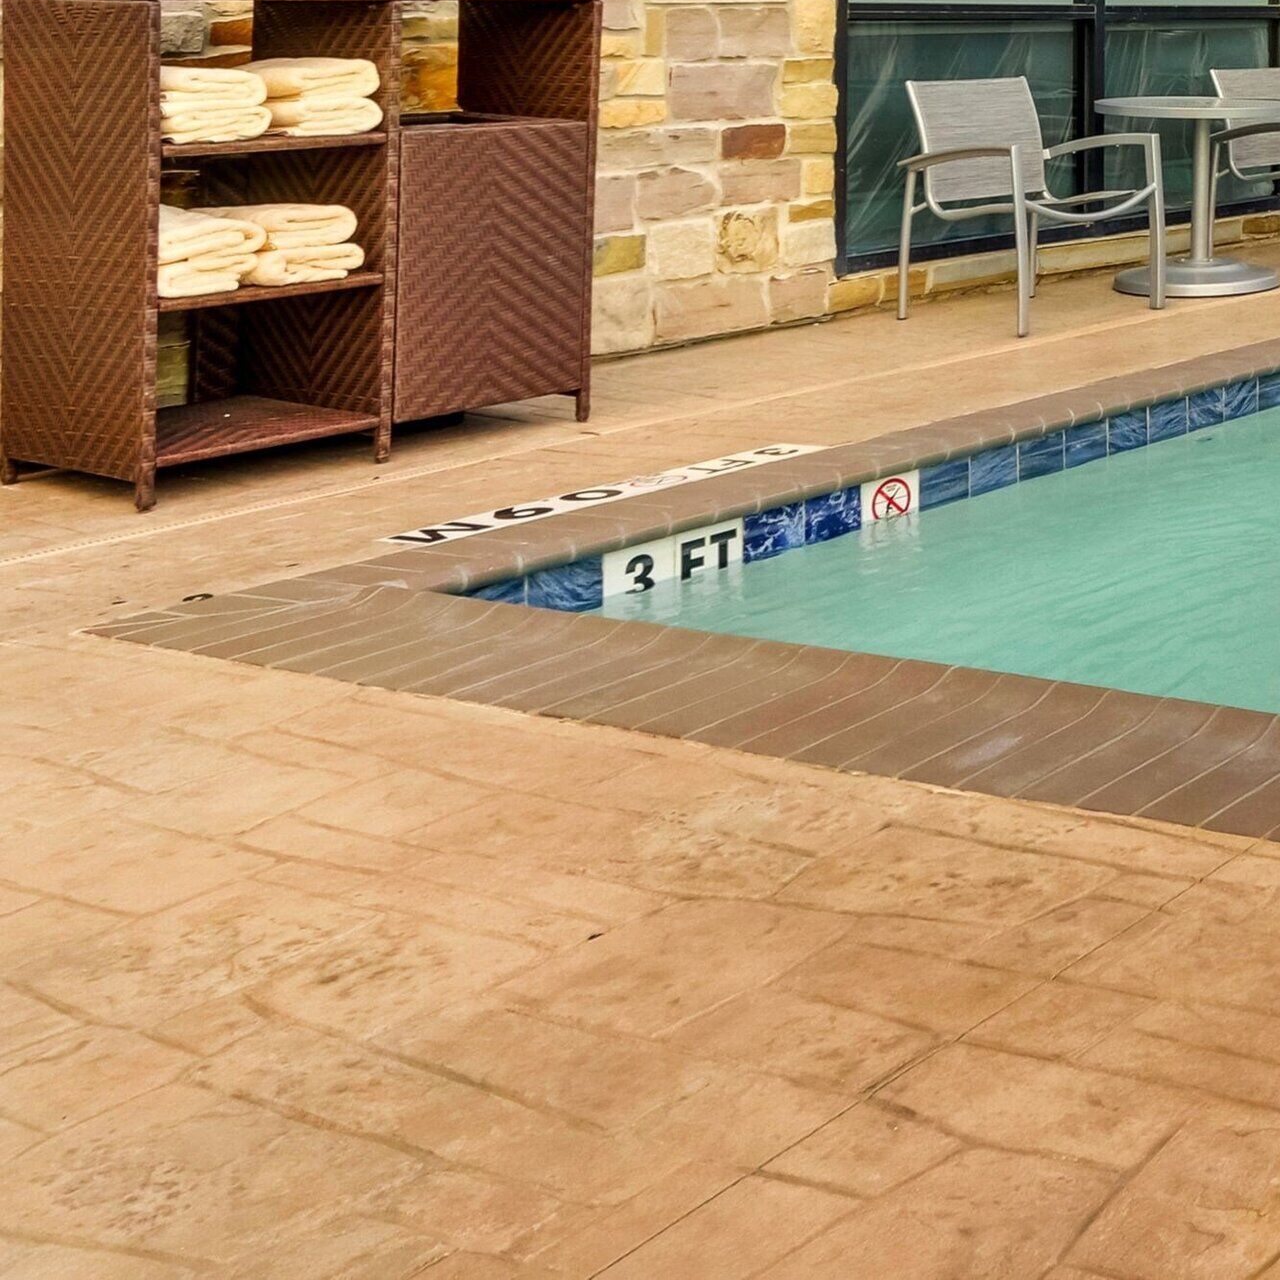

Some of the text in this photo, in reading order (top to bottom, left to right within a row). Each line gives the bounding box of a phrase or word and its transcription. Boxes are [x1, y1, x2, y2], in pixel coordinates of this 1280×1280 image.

[690, 458, 754, 473] FT
[624, 529, 737, 594] 3 FT
